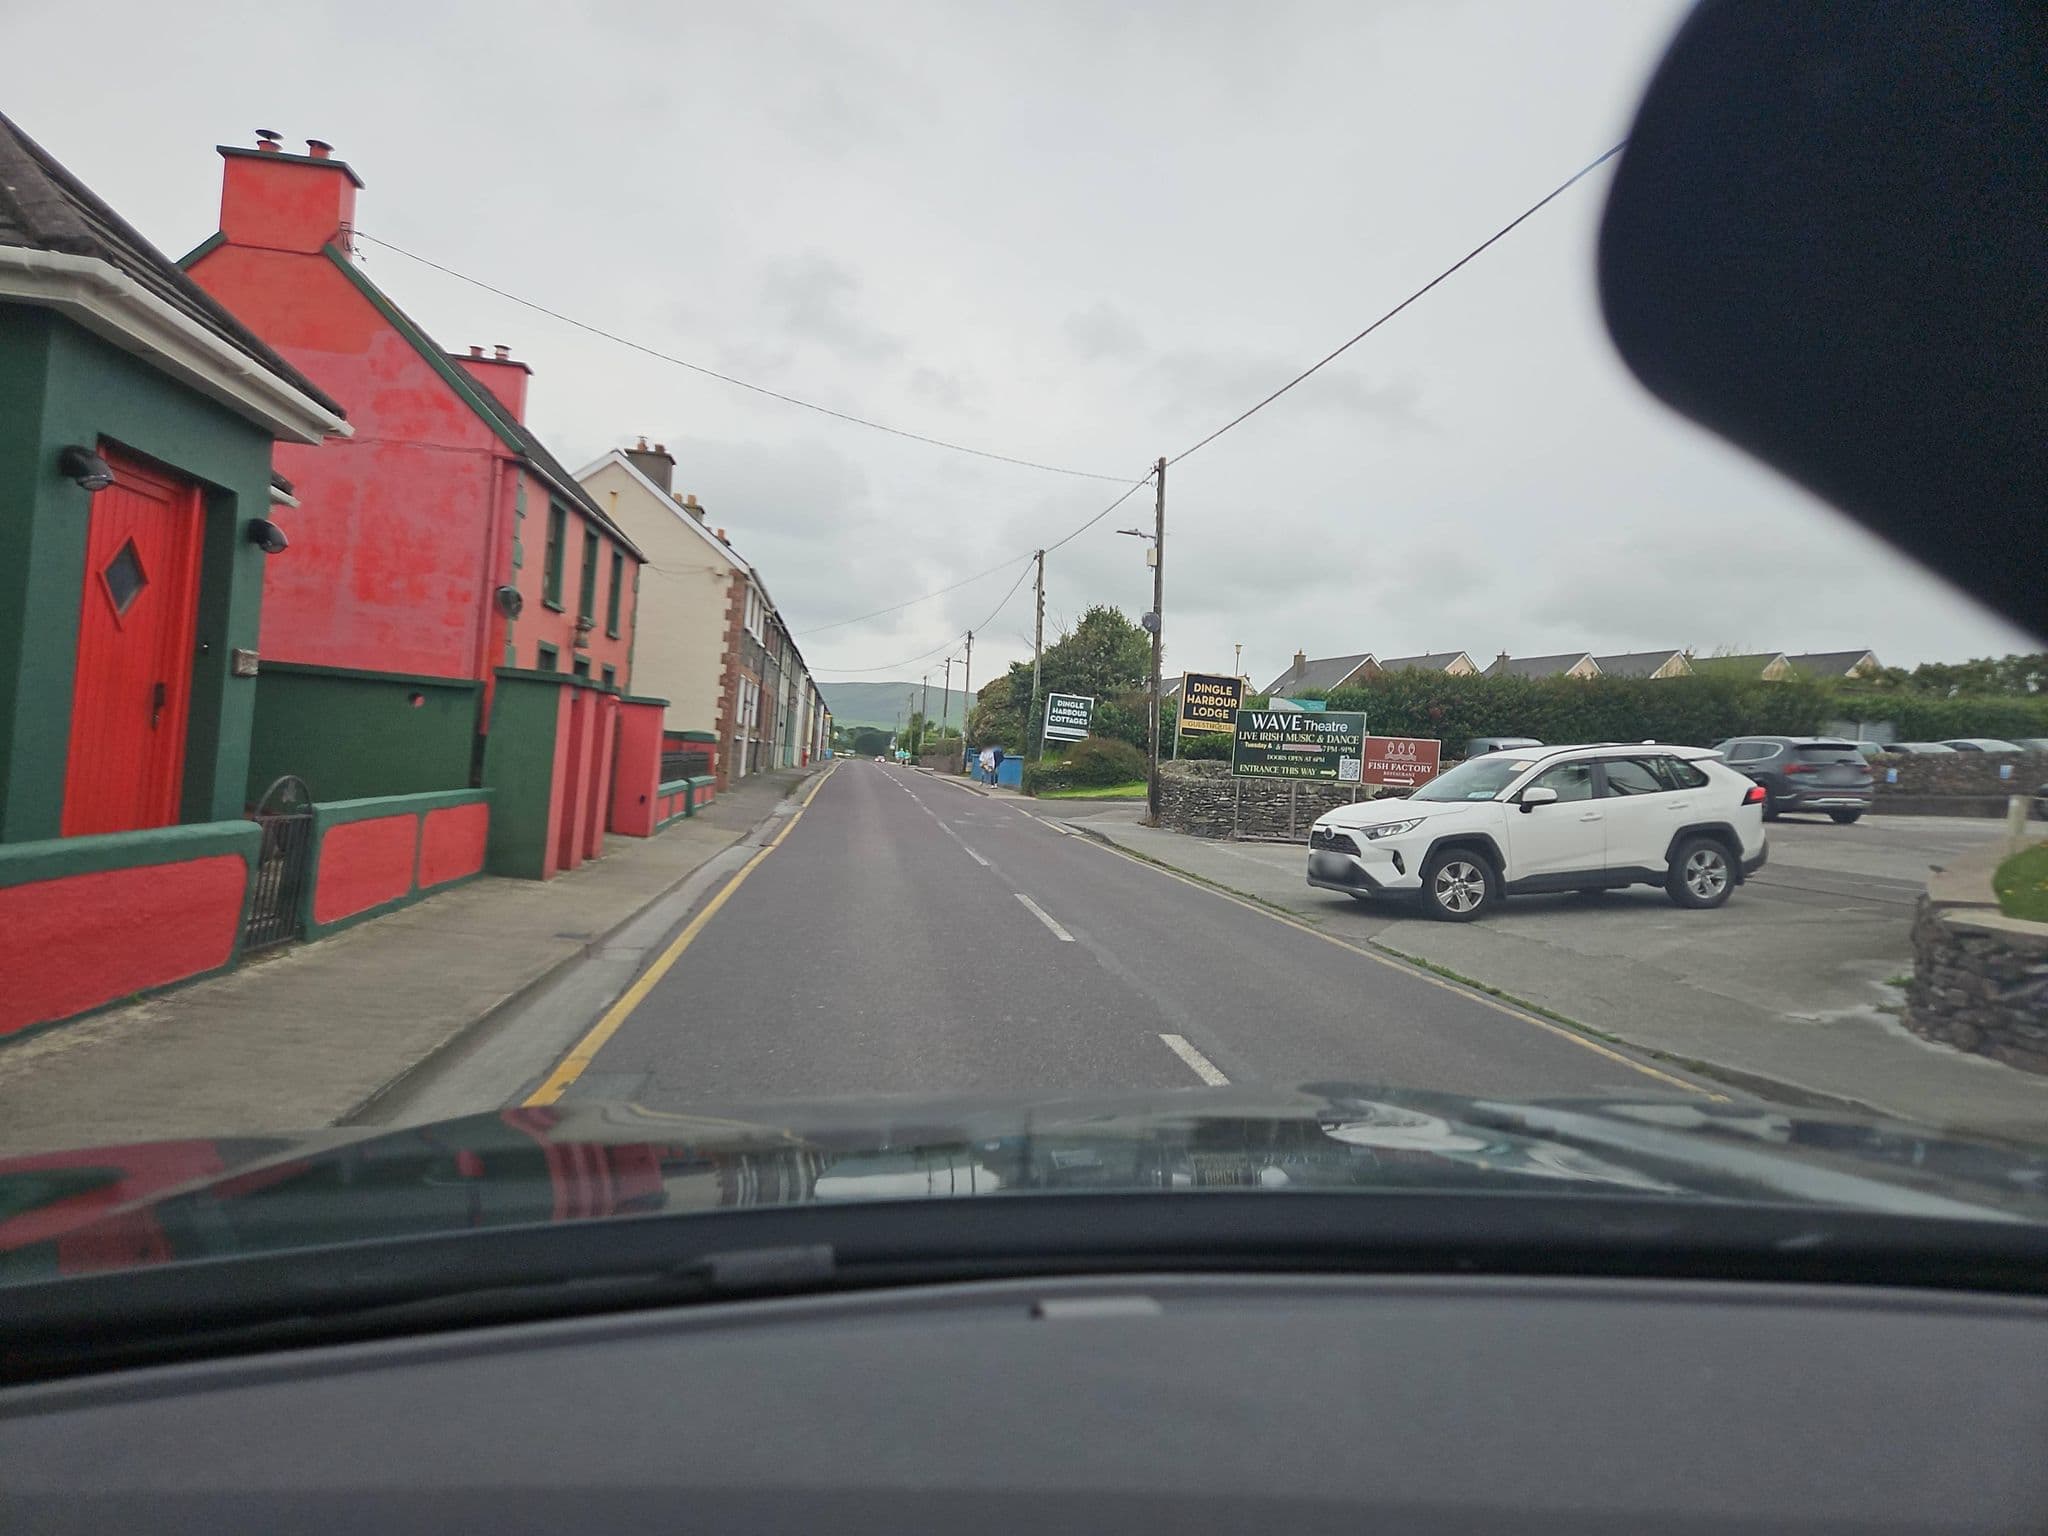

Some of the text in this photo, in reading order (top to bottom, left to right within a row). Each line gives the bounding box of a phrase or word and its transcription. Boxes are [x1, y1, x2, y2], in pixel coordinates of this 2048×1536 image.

[1194, 683, 1232, 695] DINGLE
[1057, 700, 1084, 709] DINGLE
[1187, 694, 1237, 708] HARBOUR
[1052, 707, 1087, 717] HARBOUR
[1193, 706, 1229, 719] LODGE
[1050, 715, 1087, 725] COTTAGES
[1252, 713, 1348, 732] WAVE Theatre
[1239, 731, 1360, 744] LIVE IRISH MUSIC & DANCE
[1240, 764, 1316, 775] ENTRANCE THIS WAY
[1368, 762, 1432, 773] FISH FACTORY
